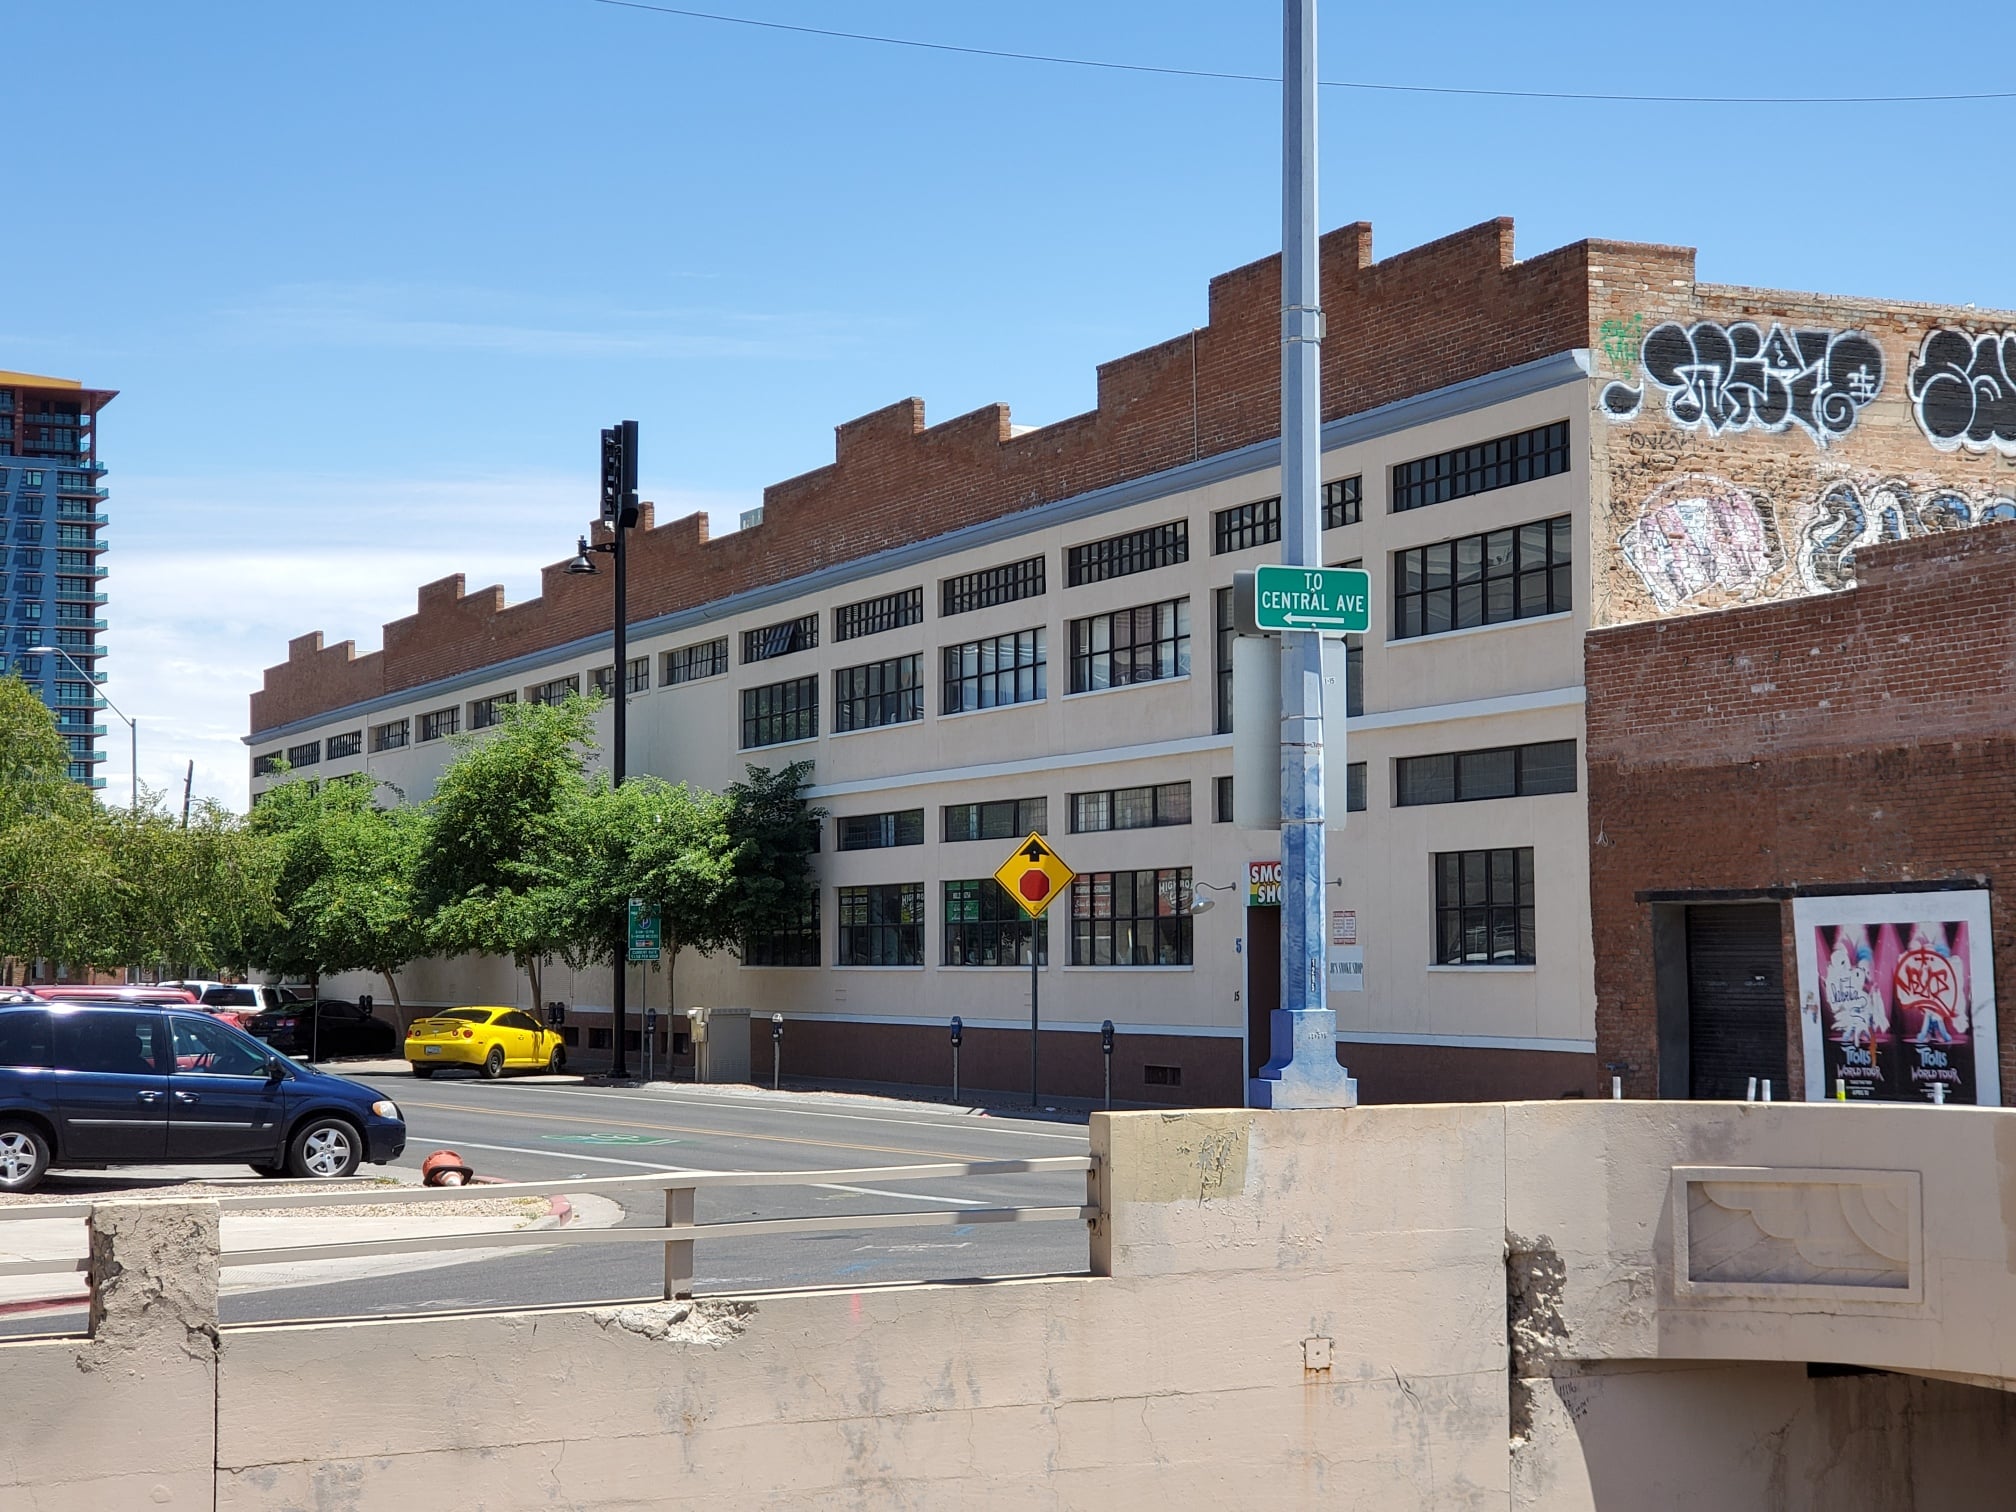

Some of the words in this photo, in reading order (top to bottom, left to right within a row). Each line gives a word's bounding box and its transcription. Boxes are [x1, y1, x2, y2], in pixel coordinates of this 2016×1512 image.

[1304, 573, 1322, 590] TO
[1262, 591, 1329, 611] CENTRAL
[1336, 595, 1364, 612] AVE
[1911, 1066, 1937, 1082] WORLD
[1937, 1067, 1962, 1084] TOUR
